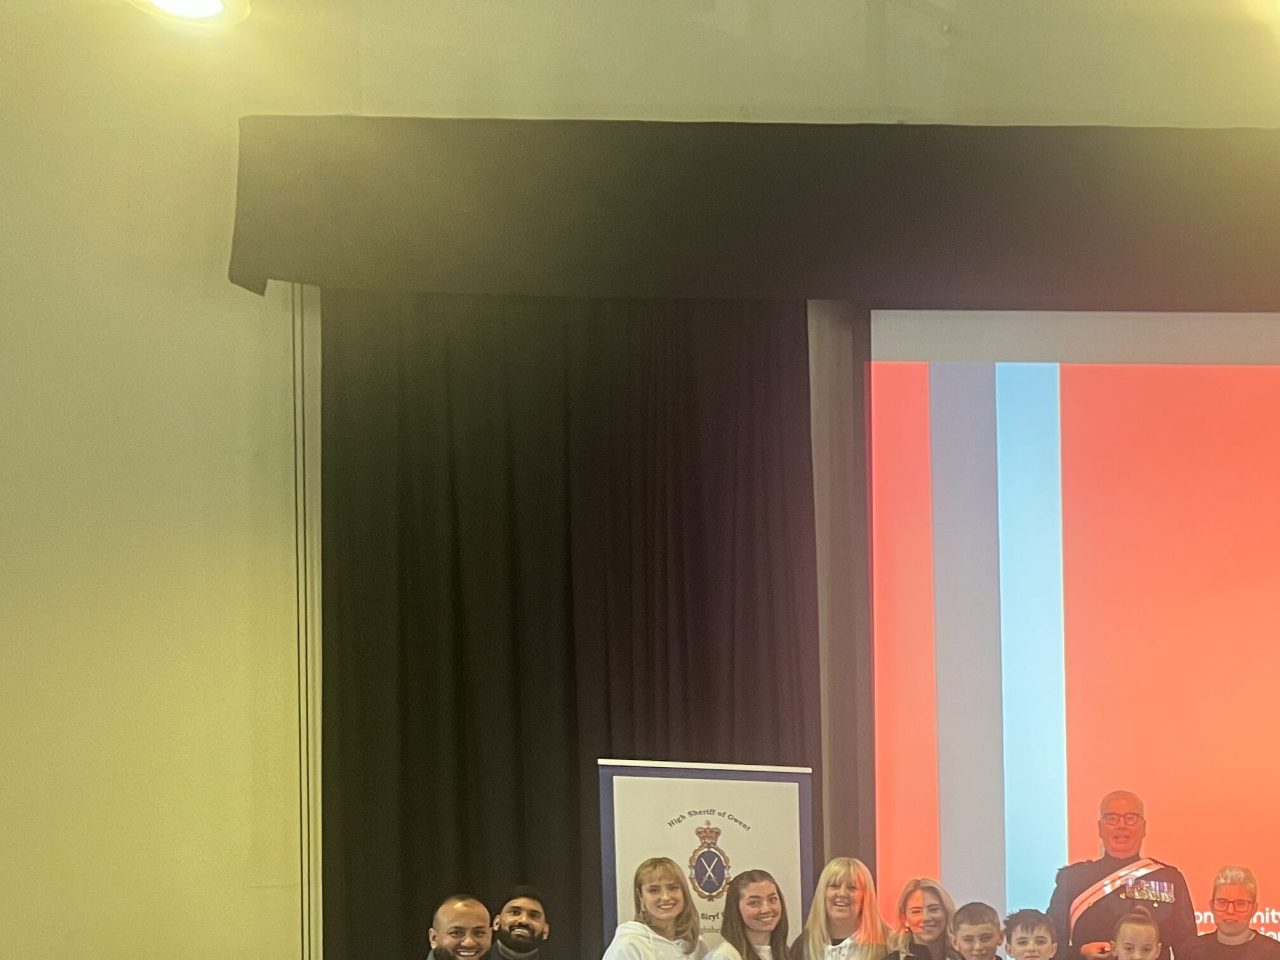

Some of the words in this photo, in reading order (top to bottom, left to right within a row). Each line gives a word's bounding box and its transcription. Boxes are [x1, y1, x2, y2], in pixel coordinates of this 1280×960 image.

[667, 814, 687, 828] High
[687, 808, 717, 817] Sheriff
[727, 814, 751, 831] Gwent
